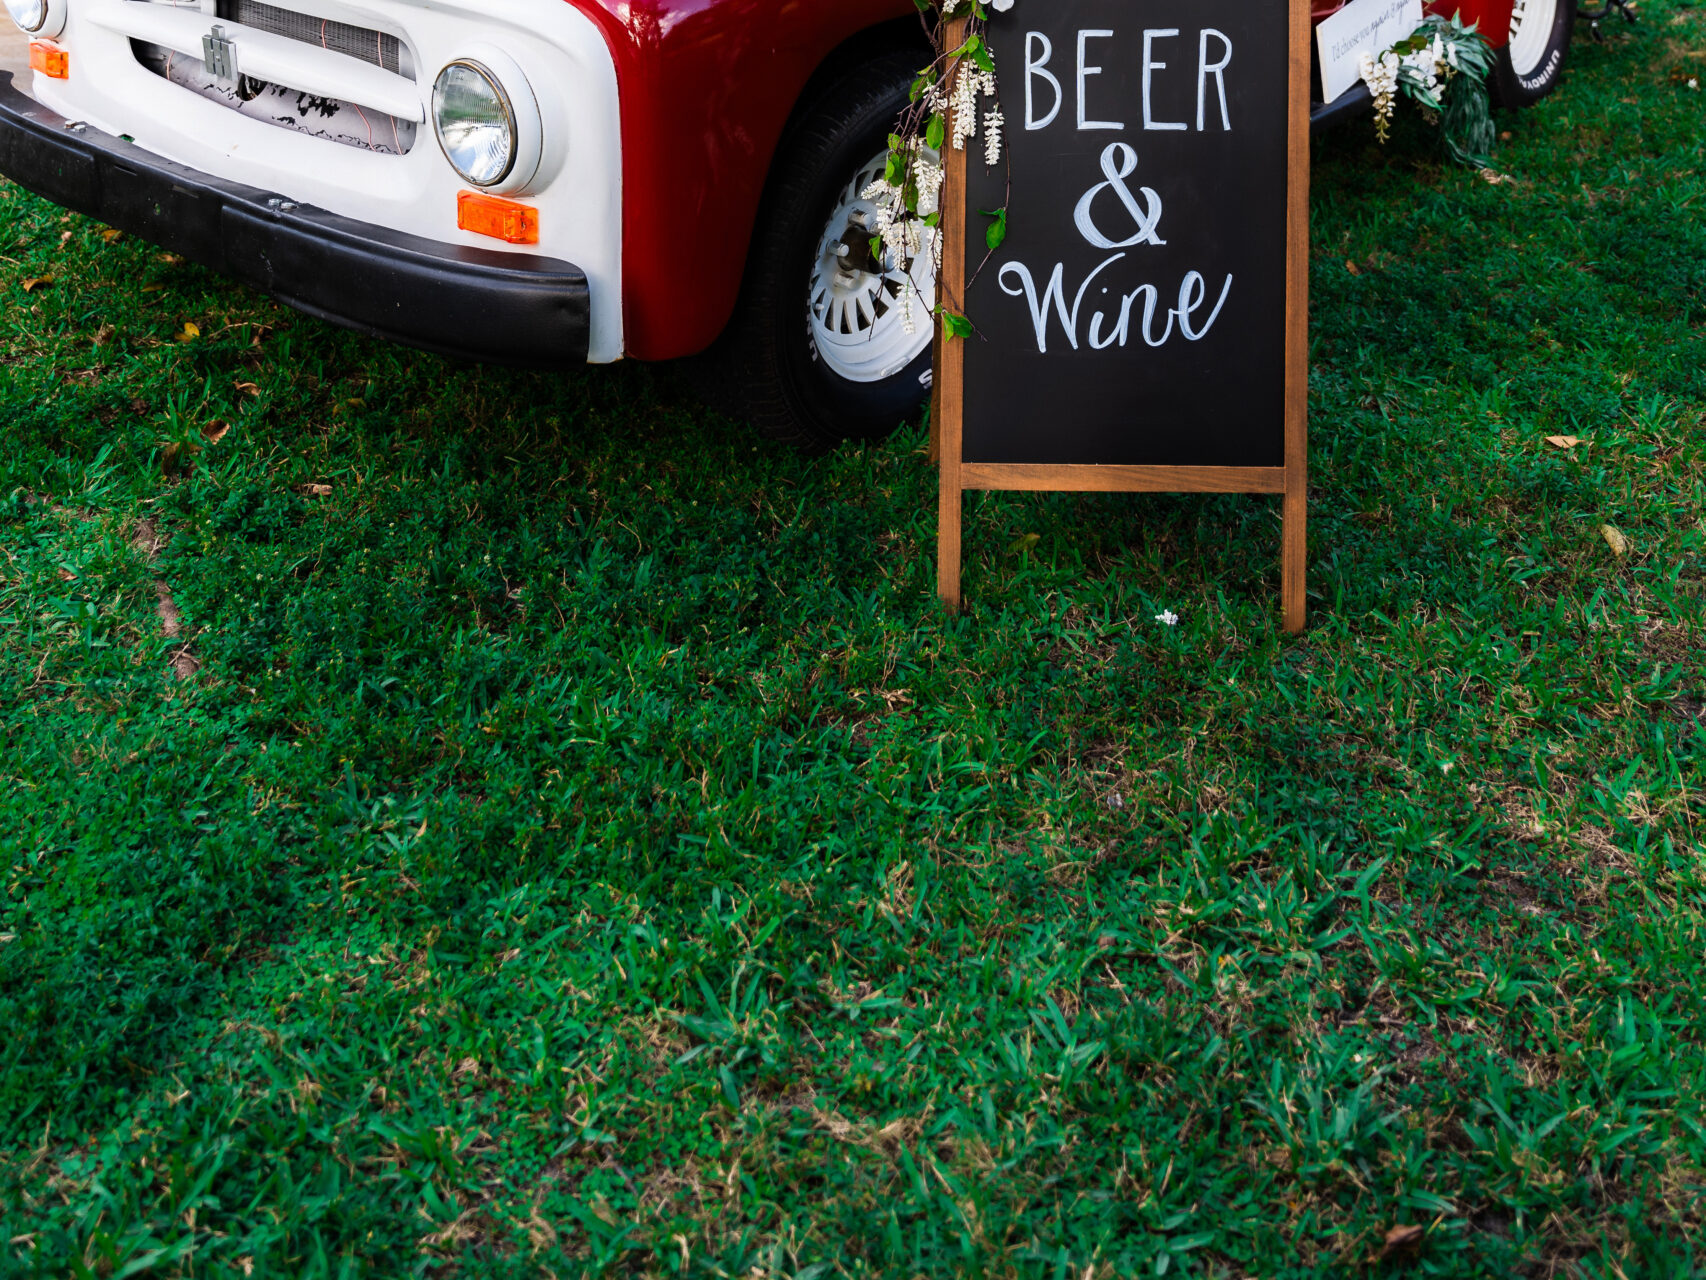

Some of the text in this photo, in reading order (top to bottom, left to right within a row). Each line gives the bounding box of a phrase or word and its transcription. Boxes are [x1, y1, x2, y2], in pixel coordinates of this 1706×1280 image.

[1369, 9, 1390, 46] again
[1024, 28, 1233, 132] BEER
[1073, 142, 1168, 250] &
[998, 252, 1233, 353] Wine
